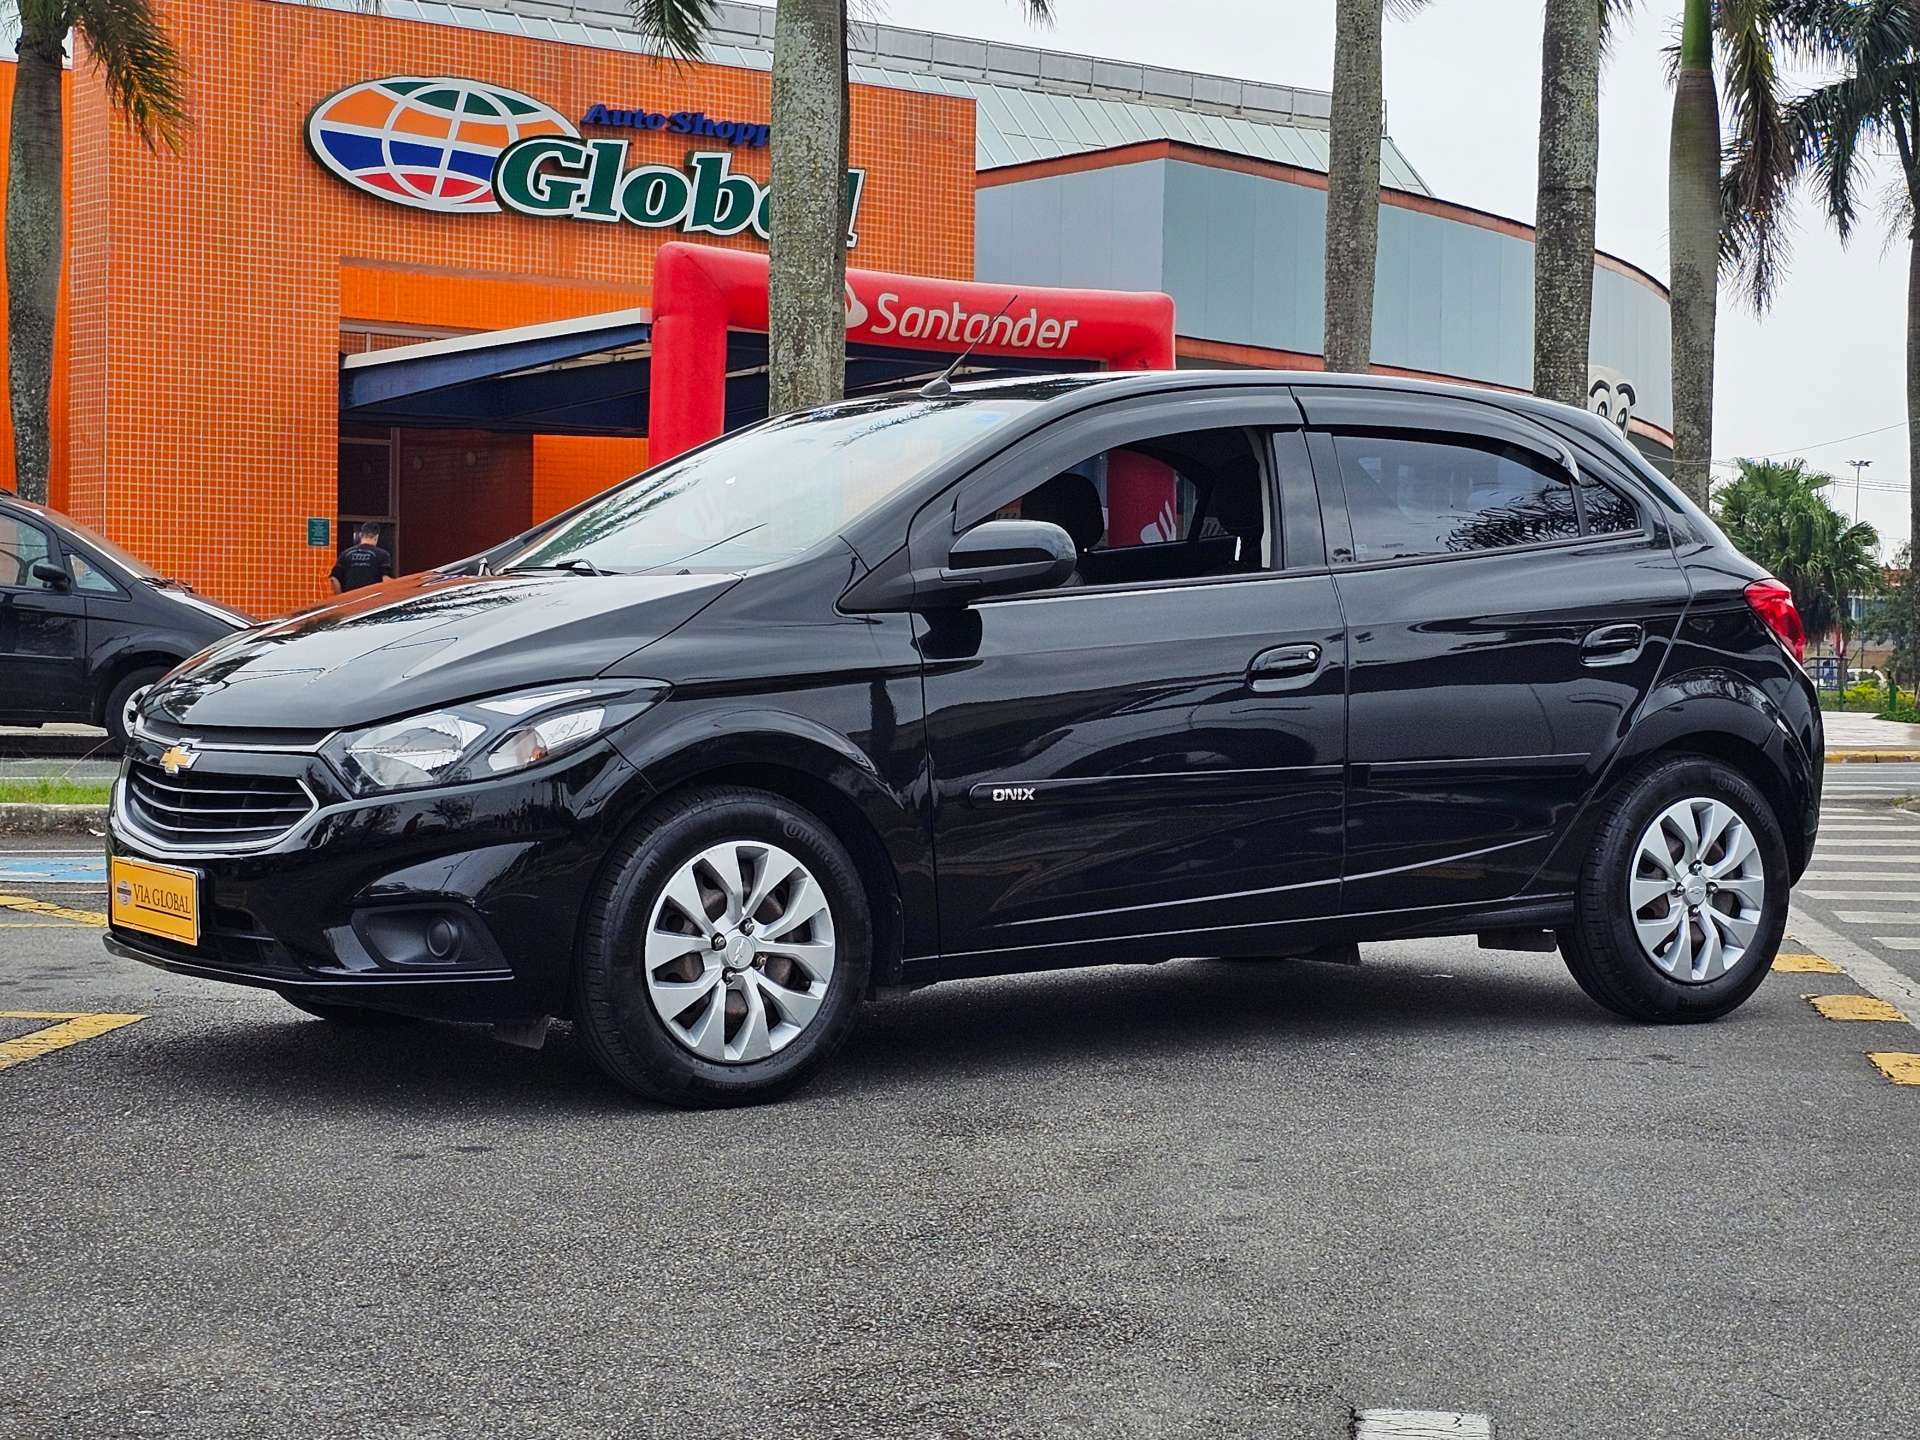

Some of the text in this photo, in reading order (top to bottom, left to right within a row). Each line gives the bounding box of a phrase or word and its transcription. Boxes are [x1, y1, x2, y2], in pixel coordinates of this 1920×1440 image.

[581, 103, 770, 147] Auto Shopp
[870, 292, 1078, 349] Santander
[992, 787, 1036, 801] ONIX
[133, 883, 191, 913] VIA GLOBAL
